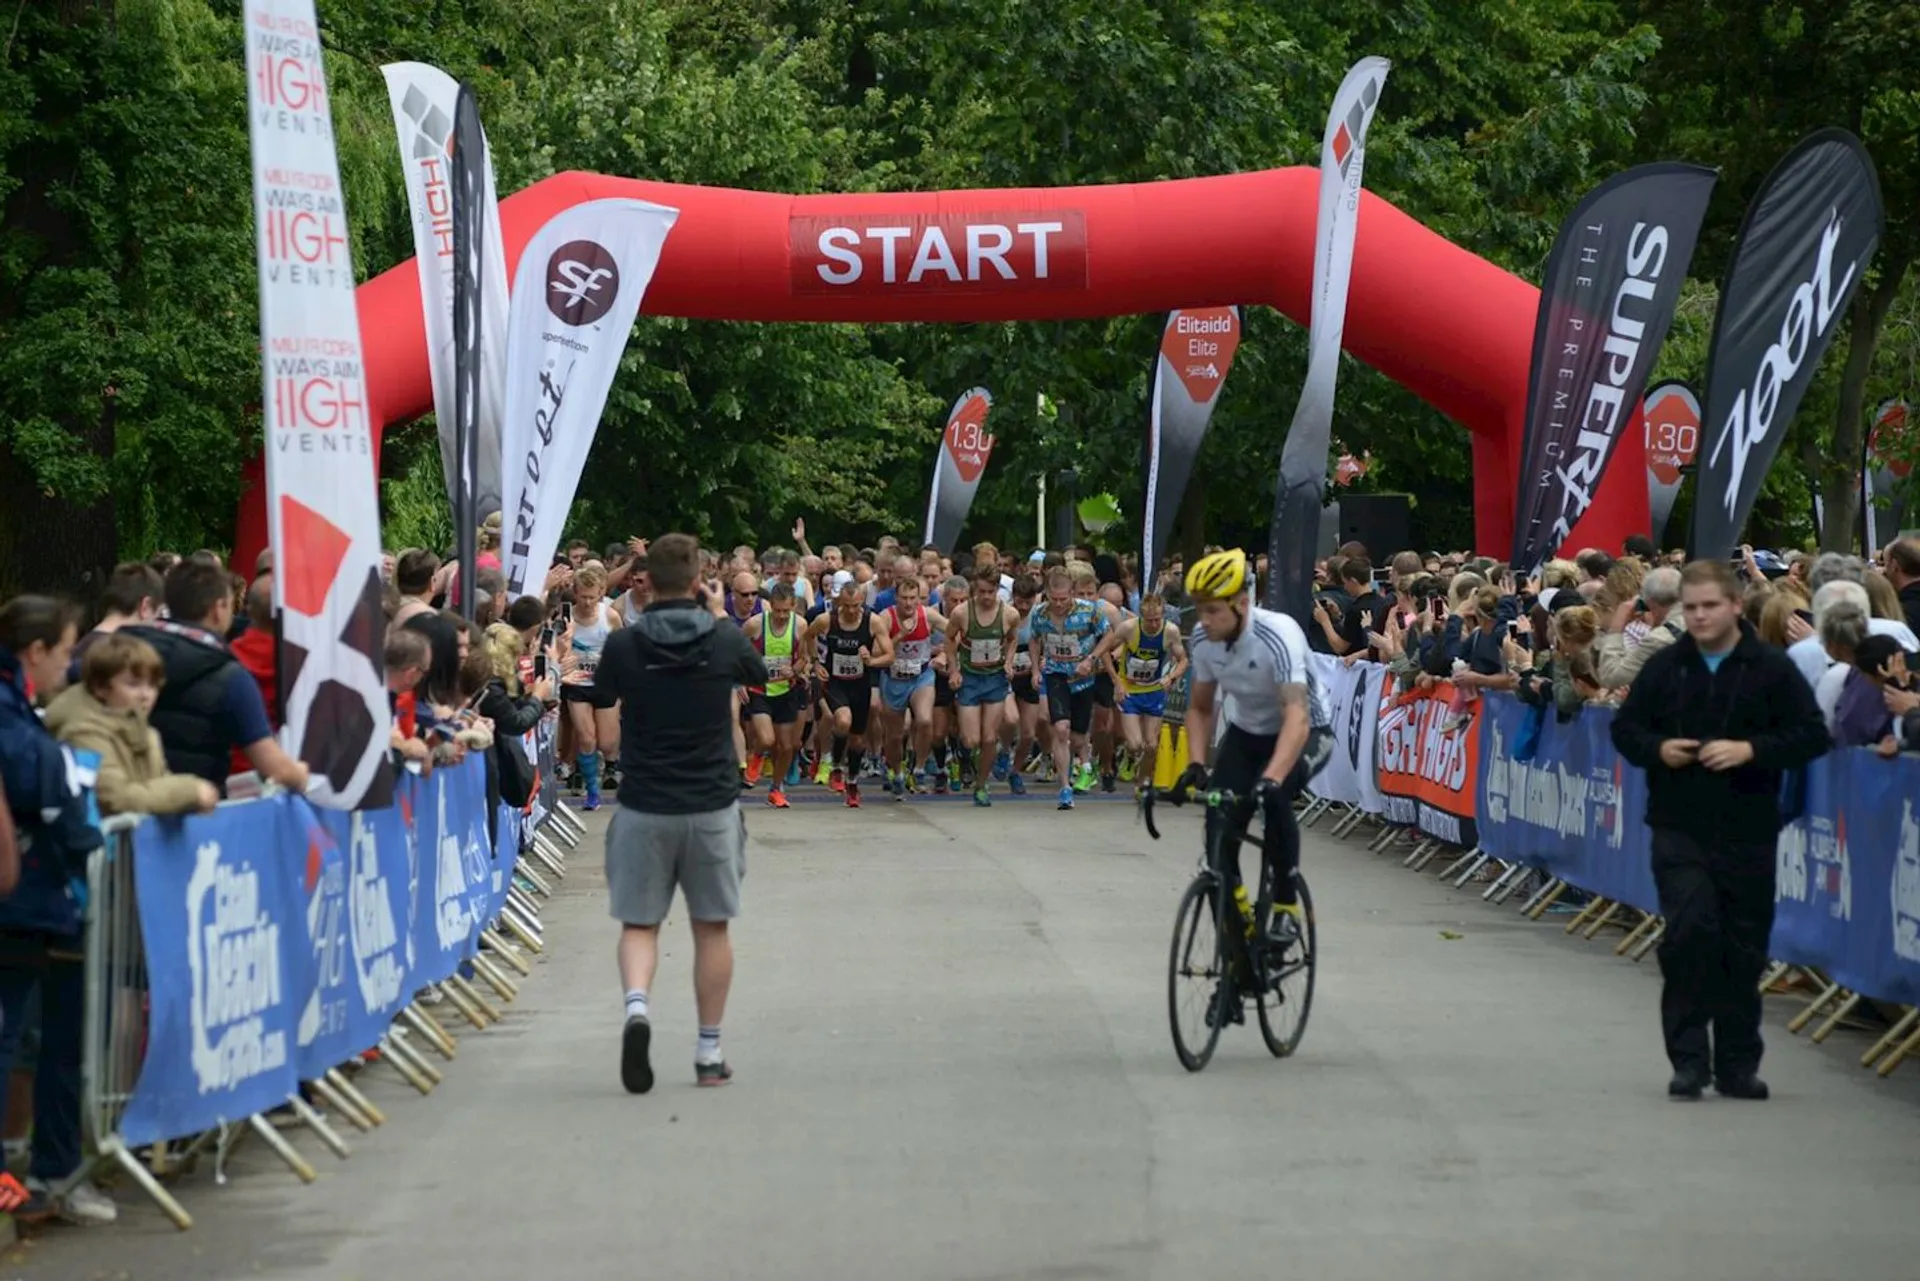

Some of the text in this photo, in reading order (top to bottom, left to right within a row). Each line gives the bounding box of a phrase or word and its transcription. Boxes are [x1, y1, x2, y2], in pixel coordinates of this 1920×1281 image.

[815, 222, 1063, 285] START
[1177, 314, 1232, 334] Elitaidd
[1188, 338, 1219, 357] Elite
[1539, 222, 1604, 489] THE PREMIUM
[1643, 421, 1698, 454] 1.30
